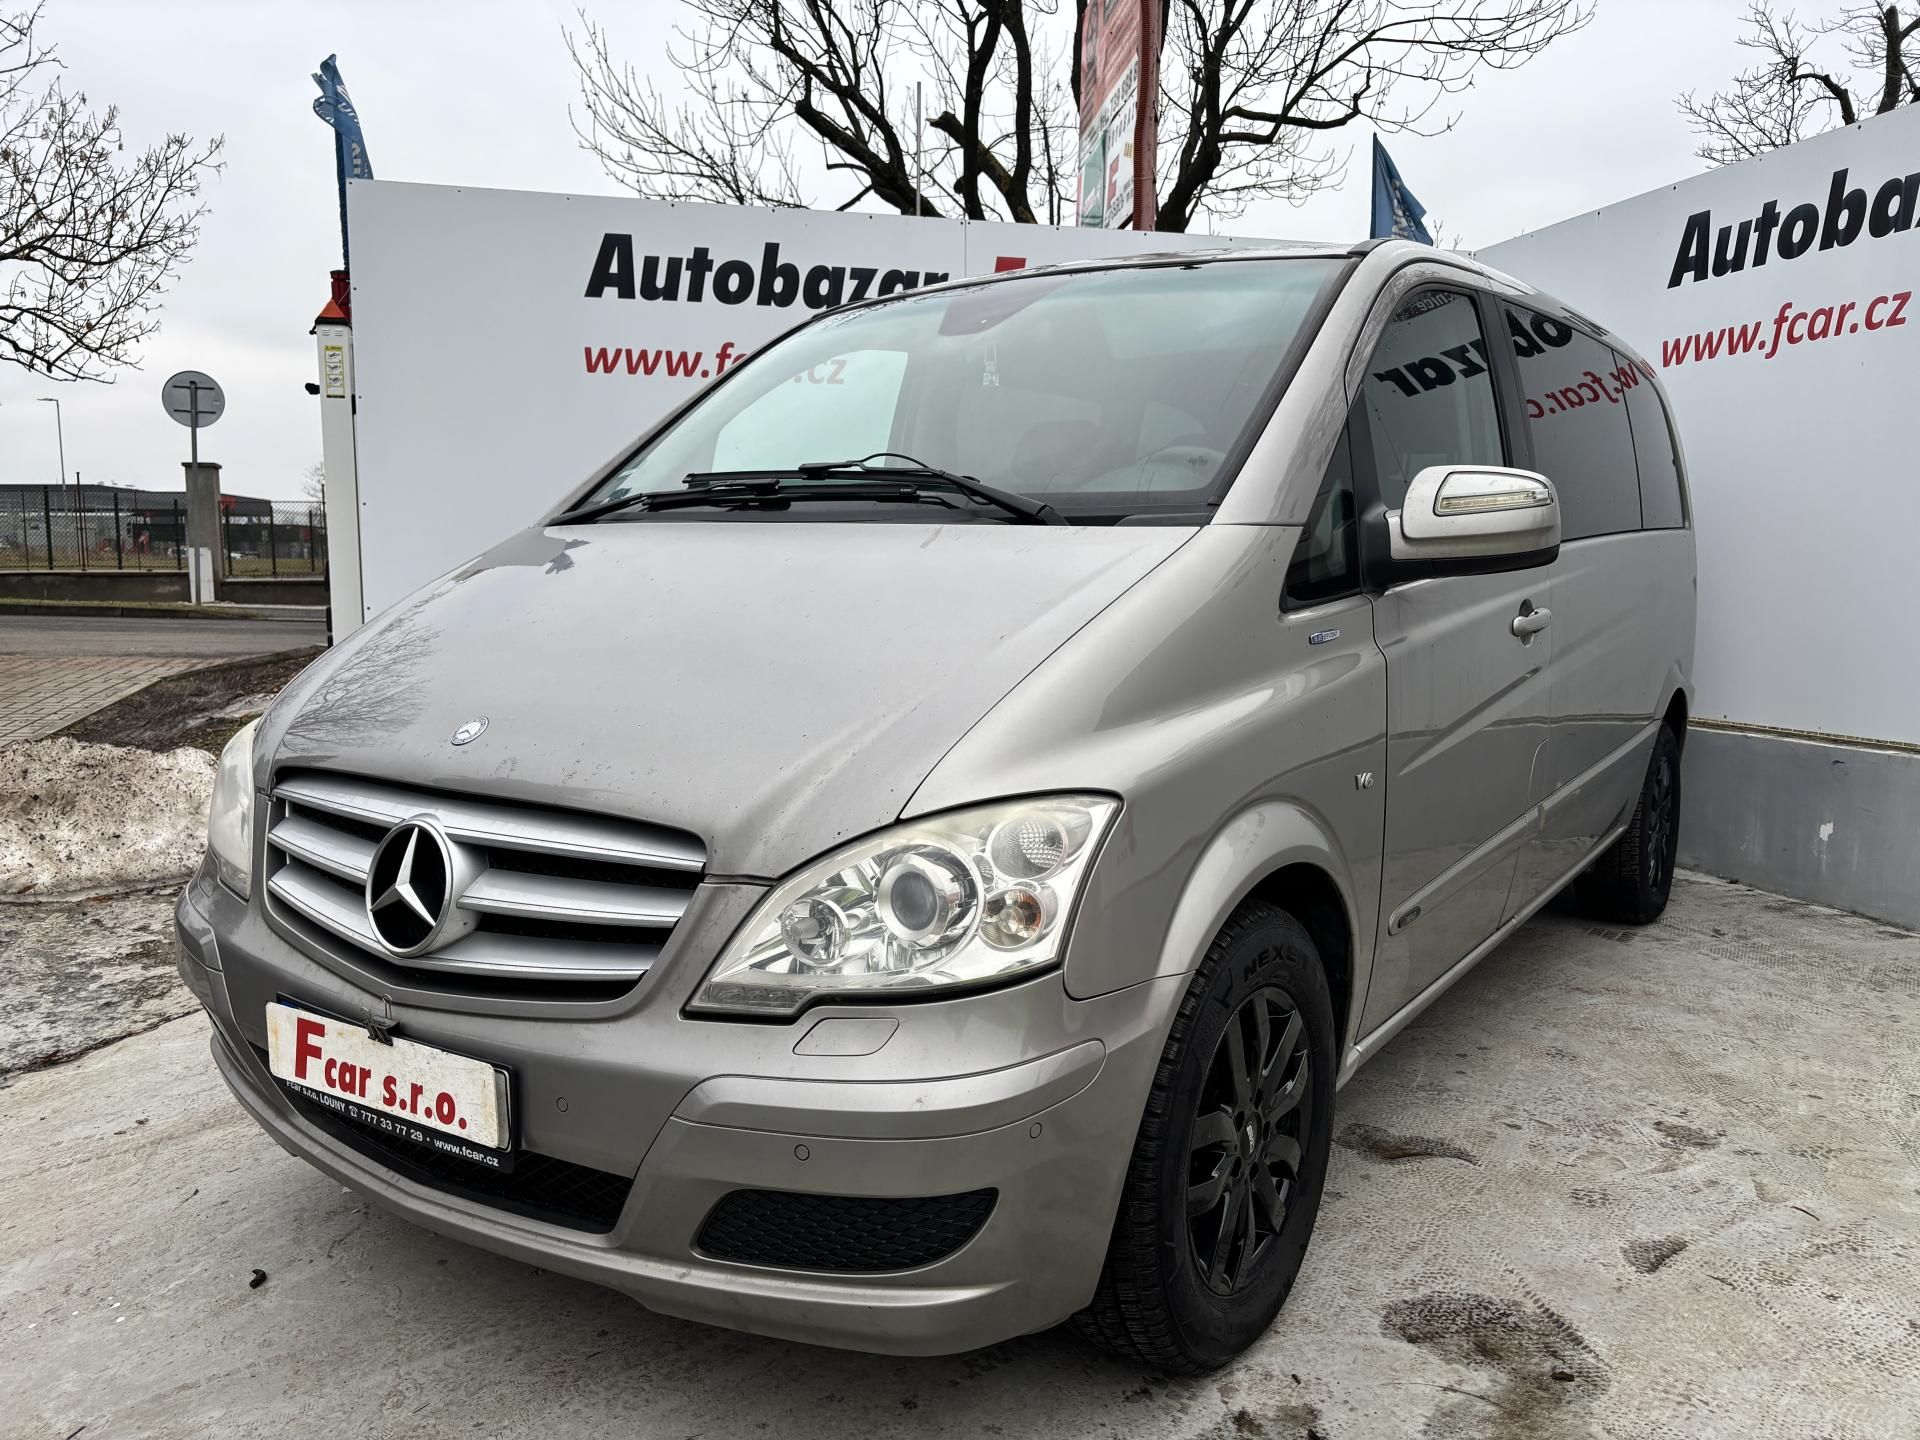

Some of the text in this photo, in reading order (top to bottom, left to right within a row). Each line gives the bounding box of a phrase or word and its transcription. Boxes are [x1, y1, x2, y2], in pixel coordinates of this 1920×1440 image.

[1667, 168, 1920, 289] Autoba
[1662, 291, 1912, 367] www.fcar.cz
[295, 1017, 467, 1129] Fcar s.r.o.
[303, 1087, 319, 1101] s.r.o.
[320, 1093, 345, 1112] LOUNY
[361, 1110, 377, 1125] 777
[380, 1117, 393, 1131] 33
[395, 1123, 407, 1136] 77
[410, 1128, 423, 1142] 29
[434, 1138, 499, 1167] www.fcar.cz
